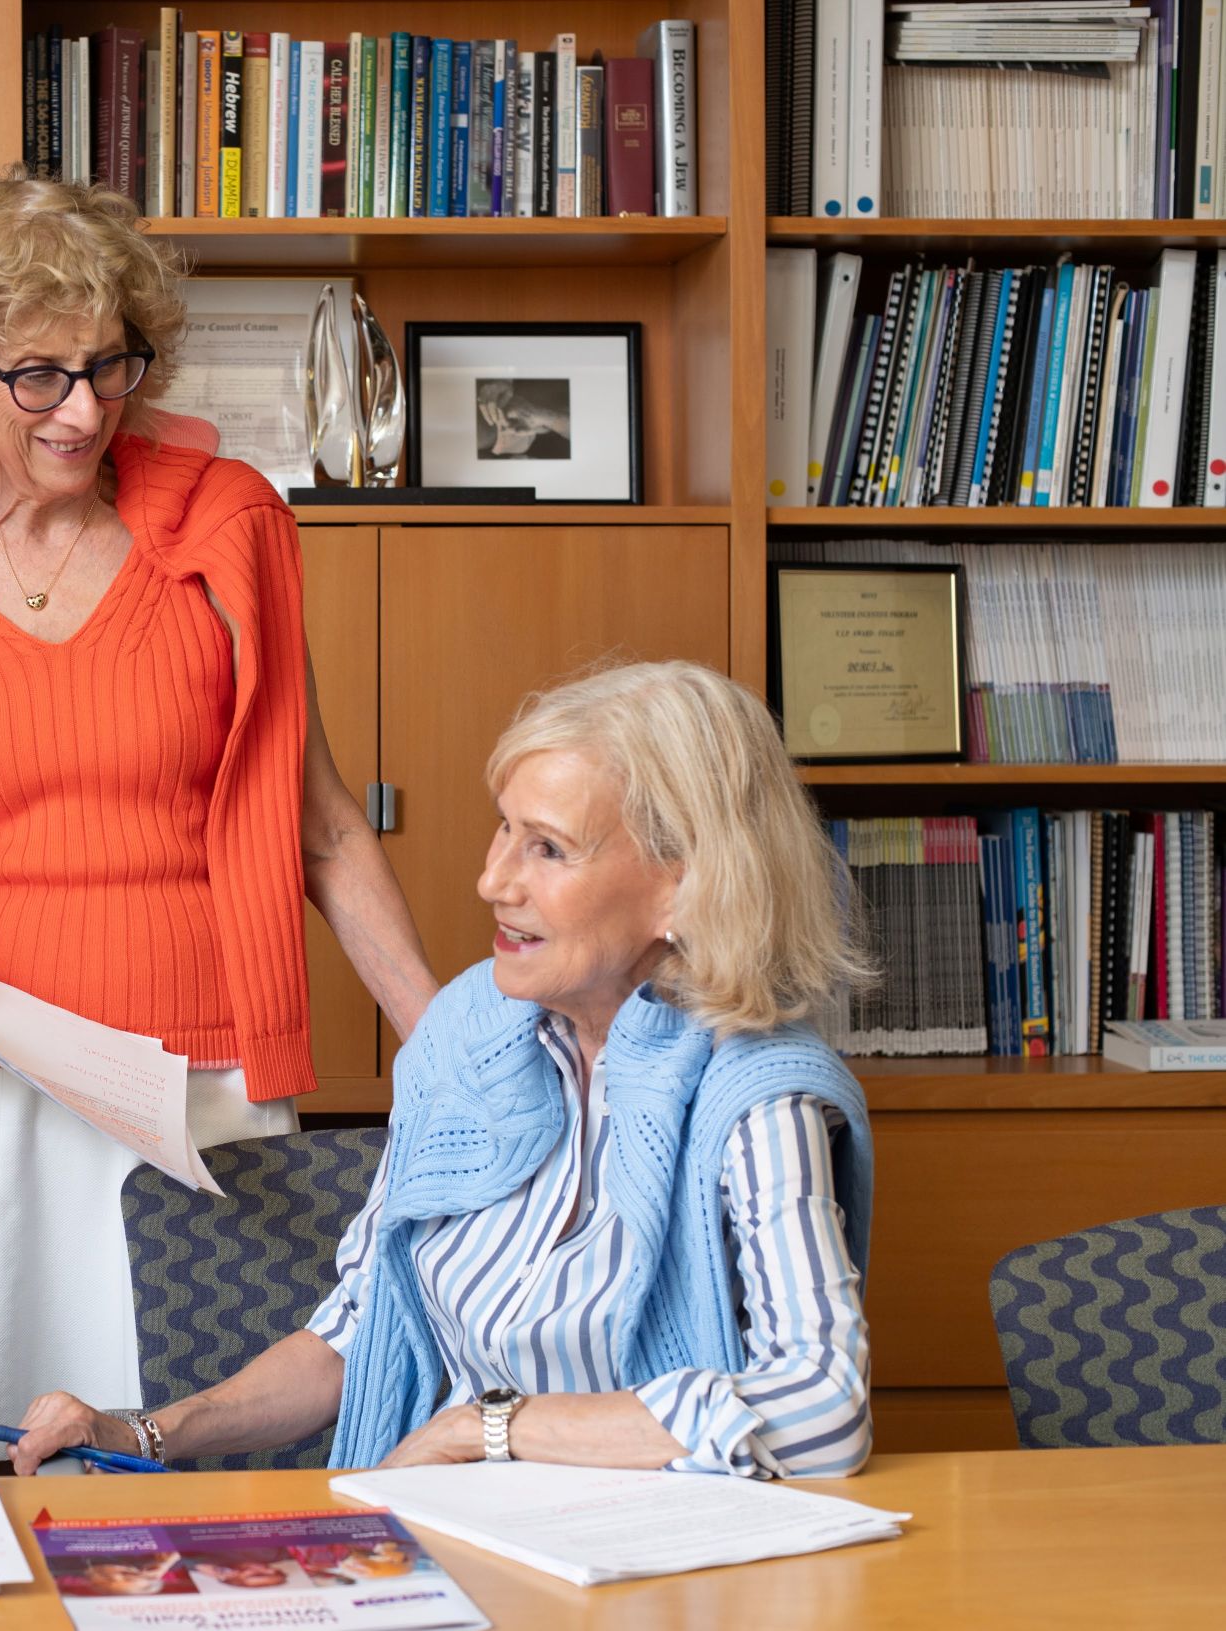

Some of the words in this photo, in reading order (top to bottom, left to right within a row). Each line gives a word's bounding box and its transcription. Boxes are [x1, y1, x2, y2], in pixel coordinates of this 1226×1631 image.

[330, 59, 343, 85] CALL
[672, 49, 687, 134] BECOMING
[225, 72, 240, 134] Hebrew
[330, 87, 342, 104] HER
[329, 104, 341, 146] BLESSED
